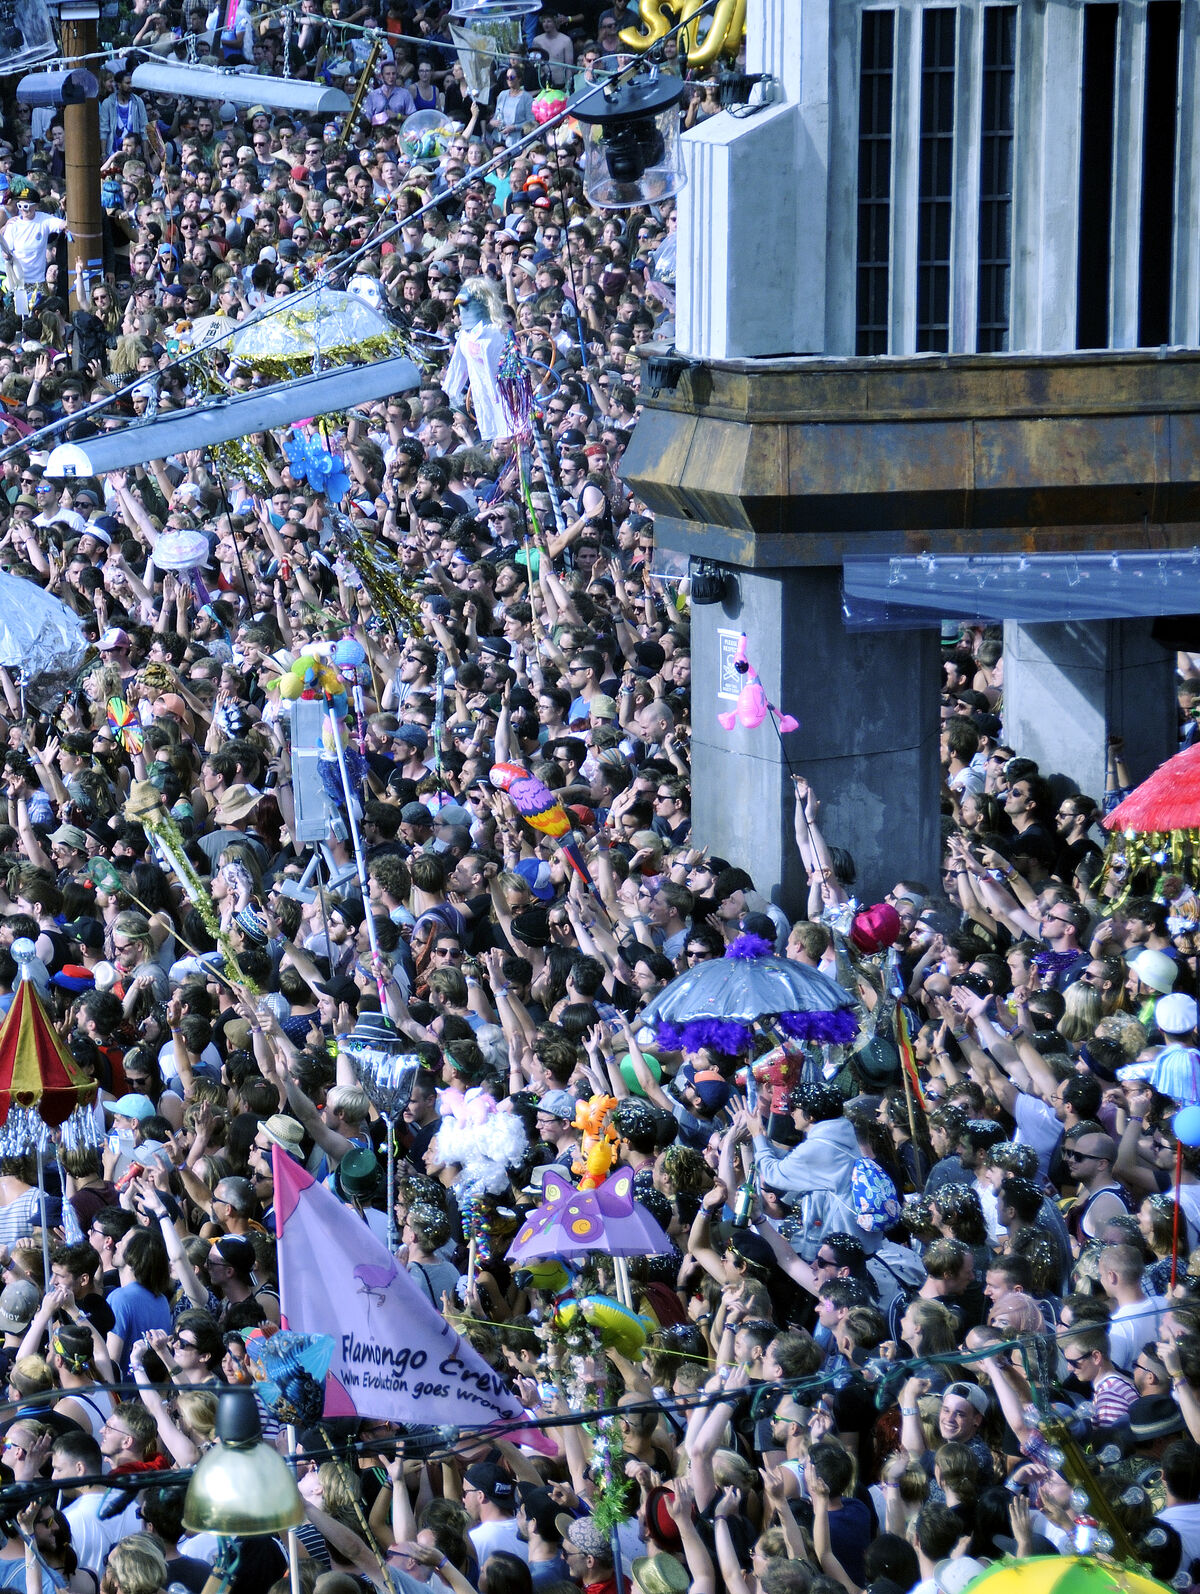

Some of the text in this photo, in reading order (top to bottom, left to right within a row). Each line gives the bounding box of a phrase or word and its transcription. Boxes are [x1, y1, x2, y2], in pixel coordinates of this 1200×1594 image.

[342, 1332, 510, 1397] Flamongo Crew
[363, 1371, 408, 1392] Evolution
[412, 1381, 450, 1399] goes
[457, 1387, 514, 1420] wrong
